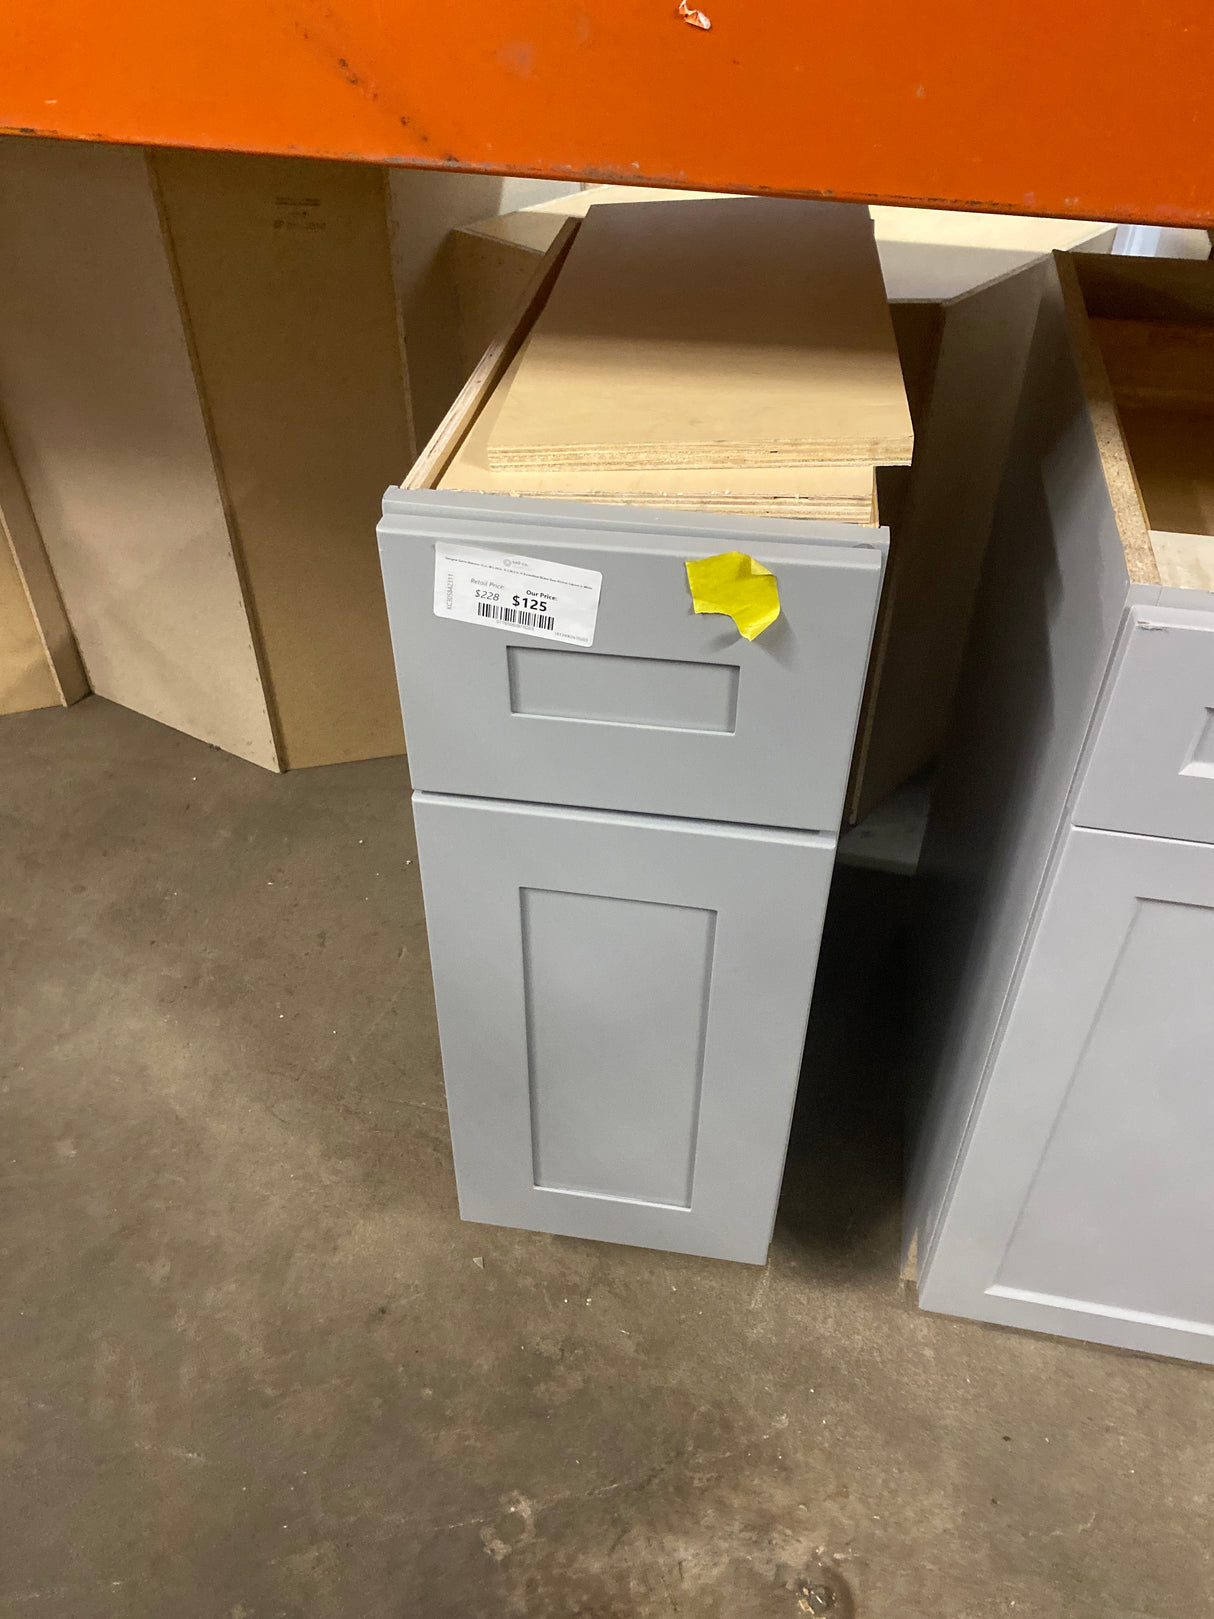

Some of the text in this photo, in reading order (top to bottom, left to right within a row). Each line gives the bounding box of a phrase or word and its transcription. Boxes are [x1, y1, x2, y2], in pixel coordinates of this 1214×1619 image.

[471, 578, 488, 587] Retail
[475, 589, 499, 601] $228
[540, 592, 557, 601] Price:
[512, 594, 547, 612] $125
